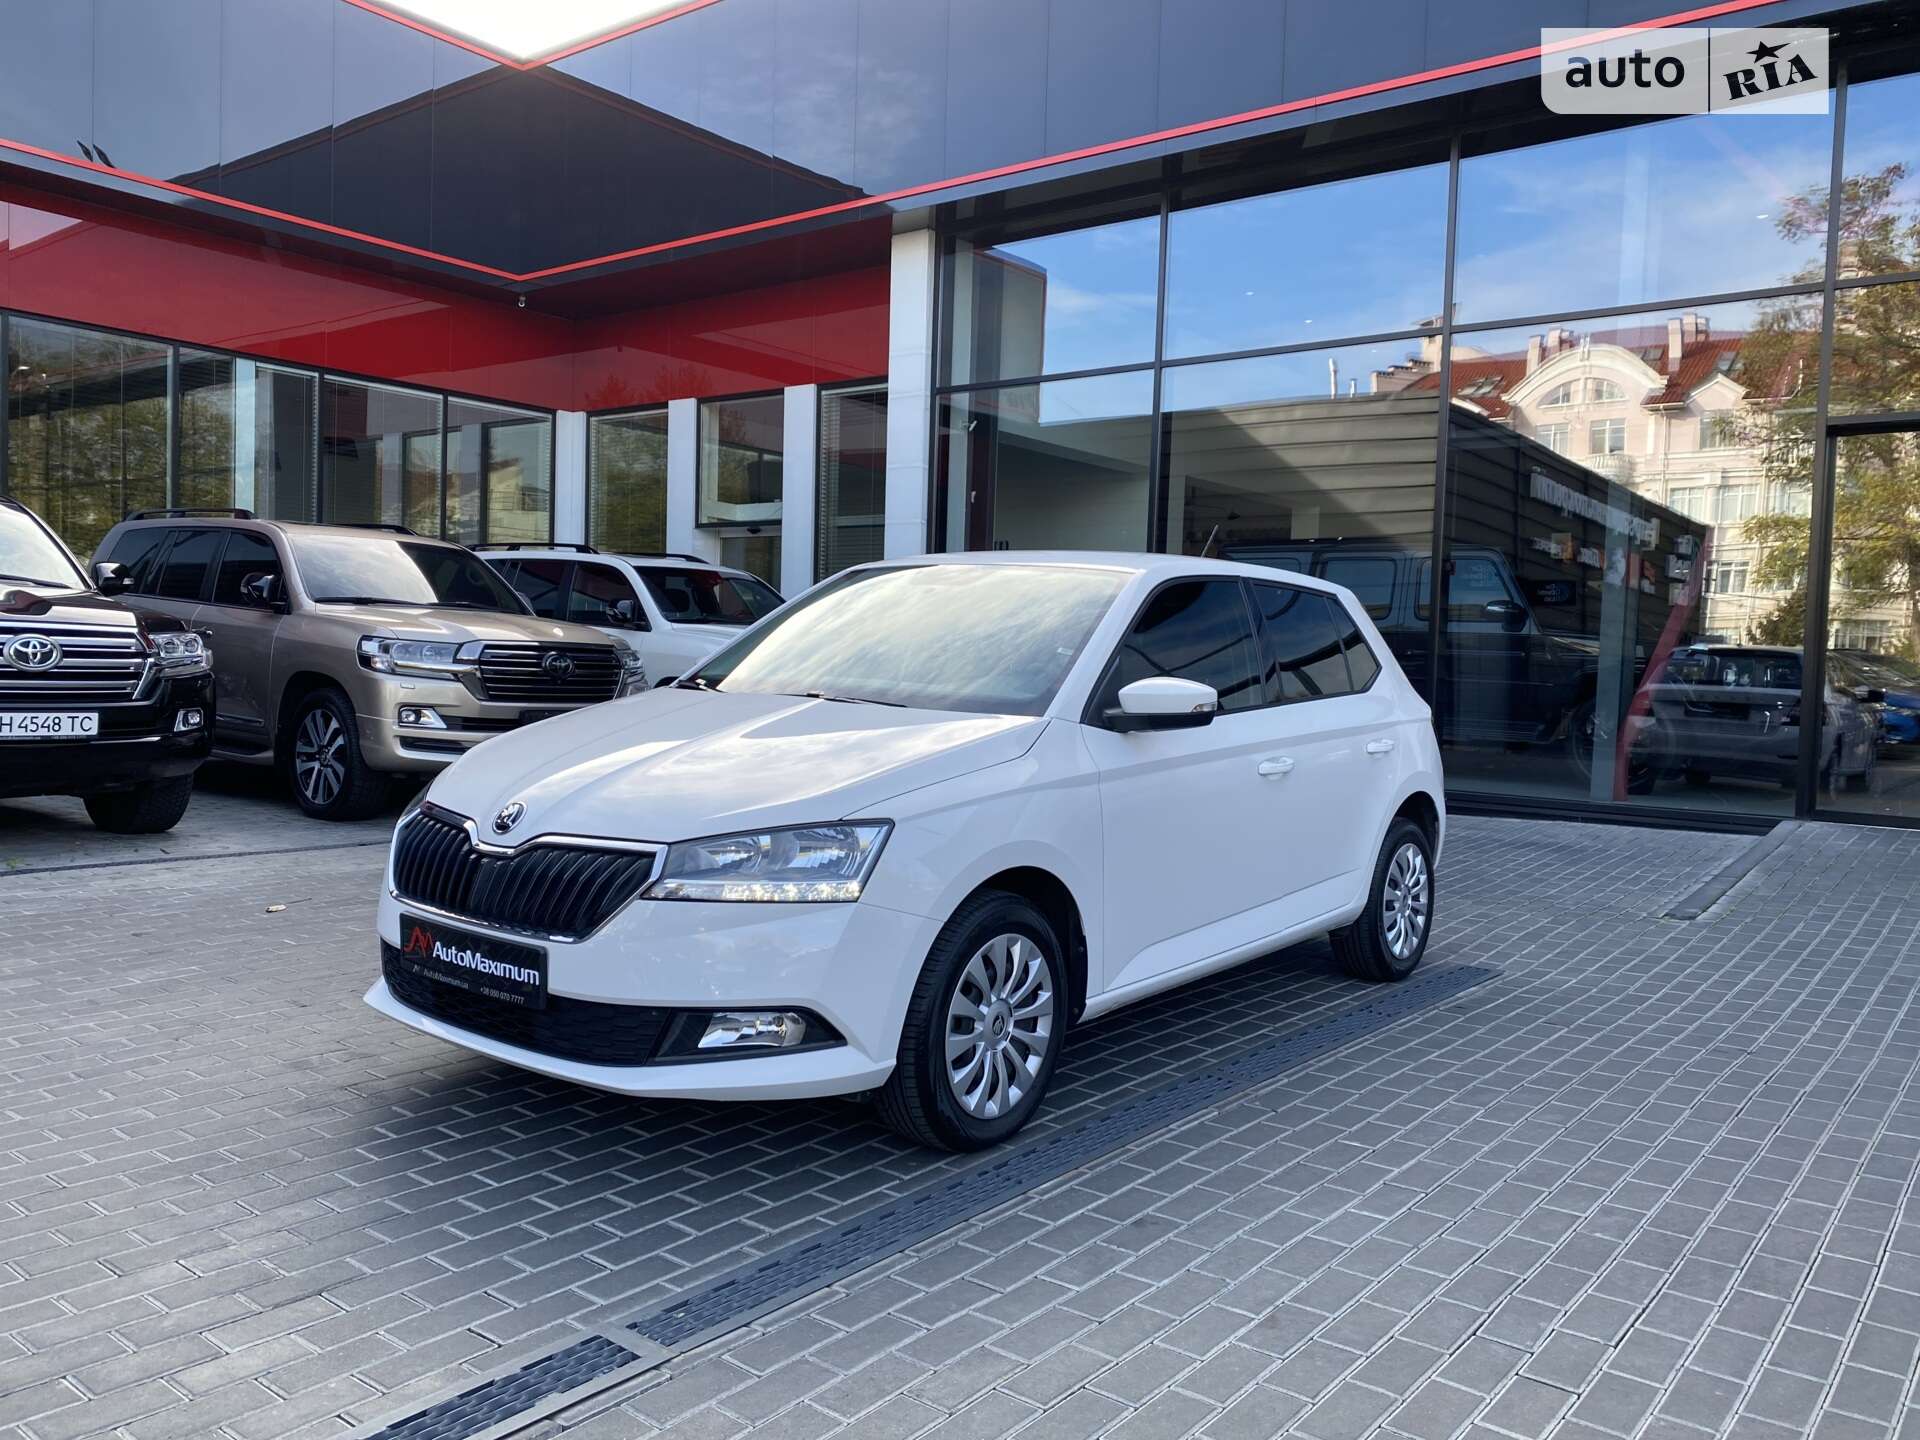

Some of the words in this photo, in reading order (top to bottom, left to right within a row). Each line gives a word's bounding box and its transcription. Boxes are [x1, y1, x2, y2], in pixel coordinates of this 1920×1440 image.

[0, 716, 13, 733] H
[17, 716, 62, 733] 4548
[66, 716, 93, 732] TC
[432, 941, 540, 986] AutoMaximum
